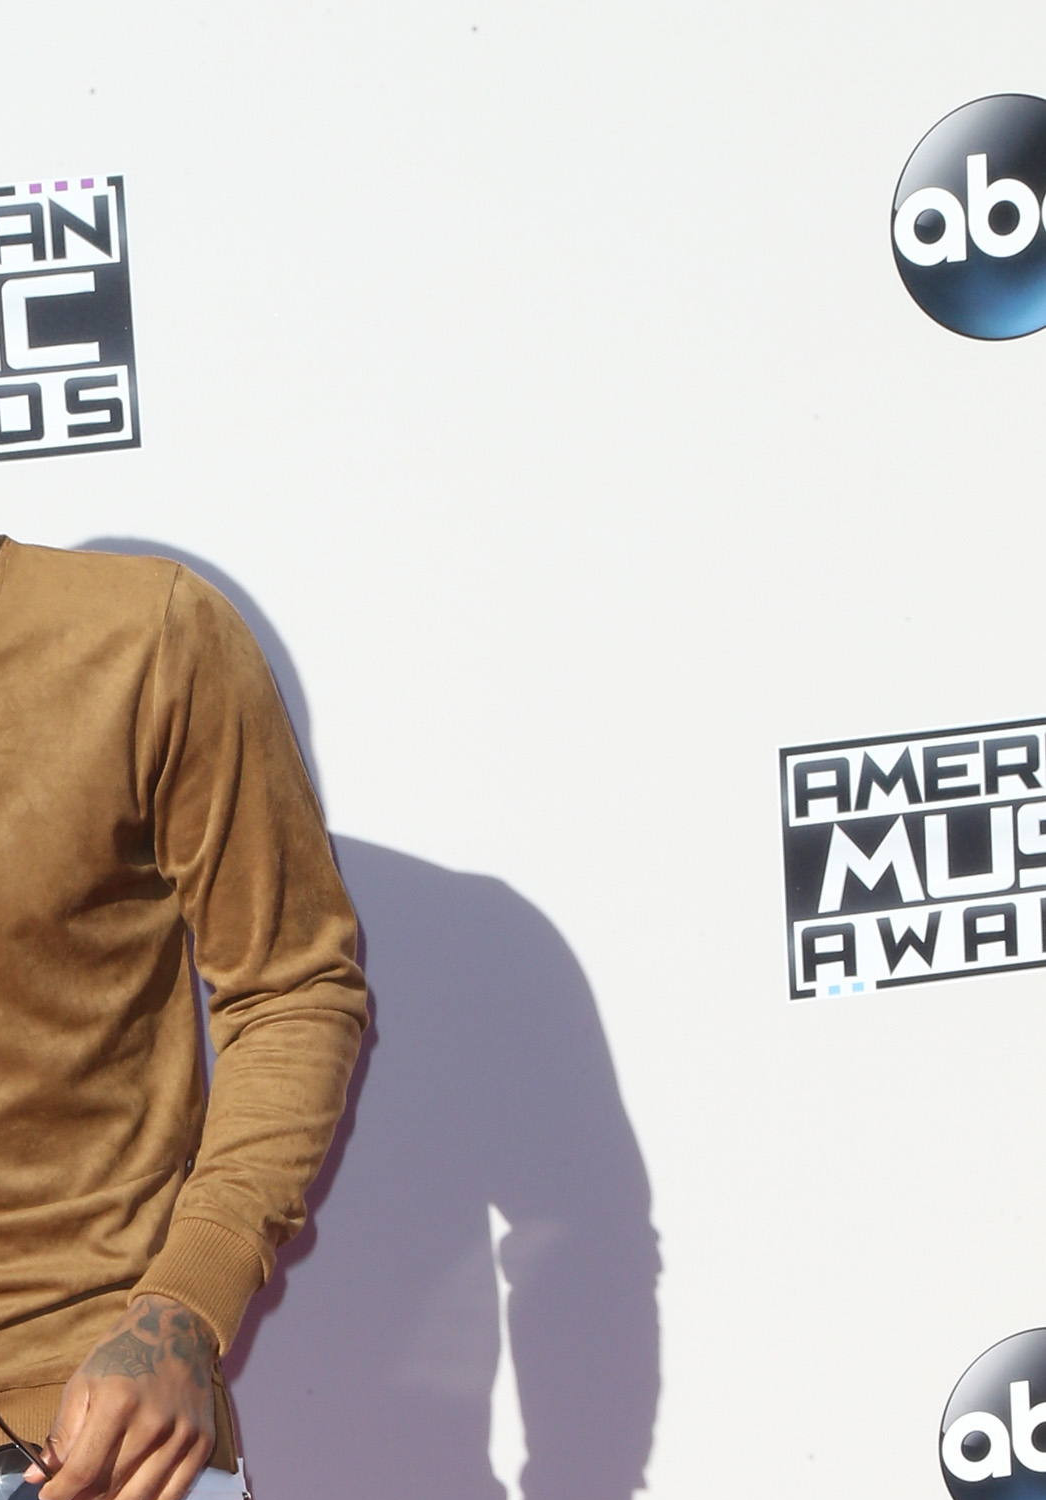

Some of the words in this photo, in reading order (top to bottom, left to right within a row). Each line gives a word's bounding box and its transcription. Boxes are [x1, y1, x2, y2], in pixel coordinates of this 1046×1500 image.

[894, 153, 1046, 267] ab
[793, 734, 1046, 819] AMER
[801, 898, 1046, 984] AWA
